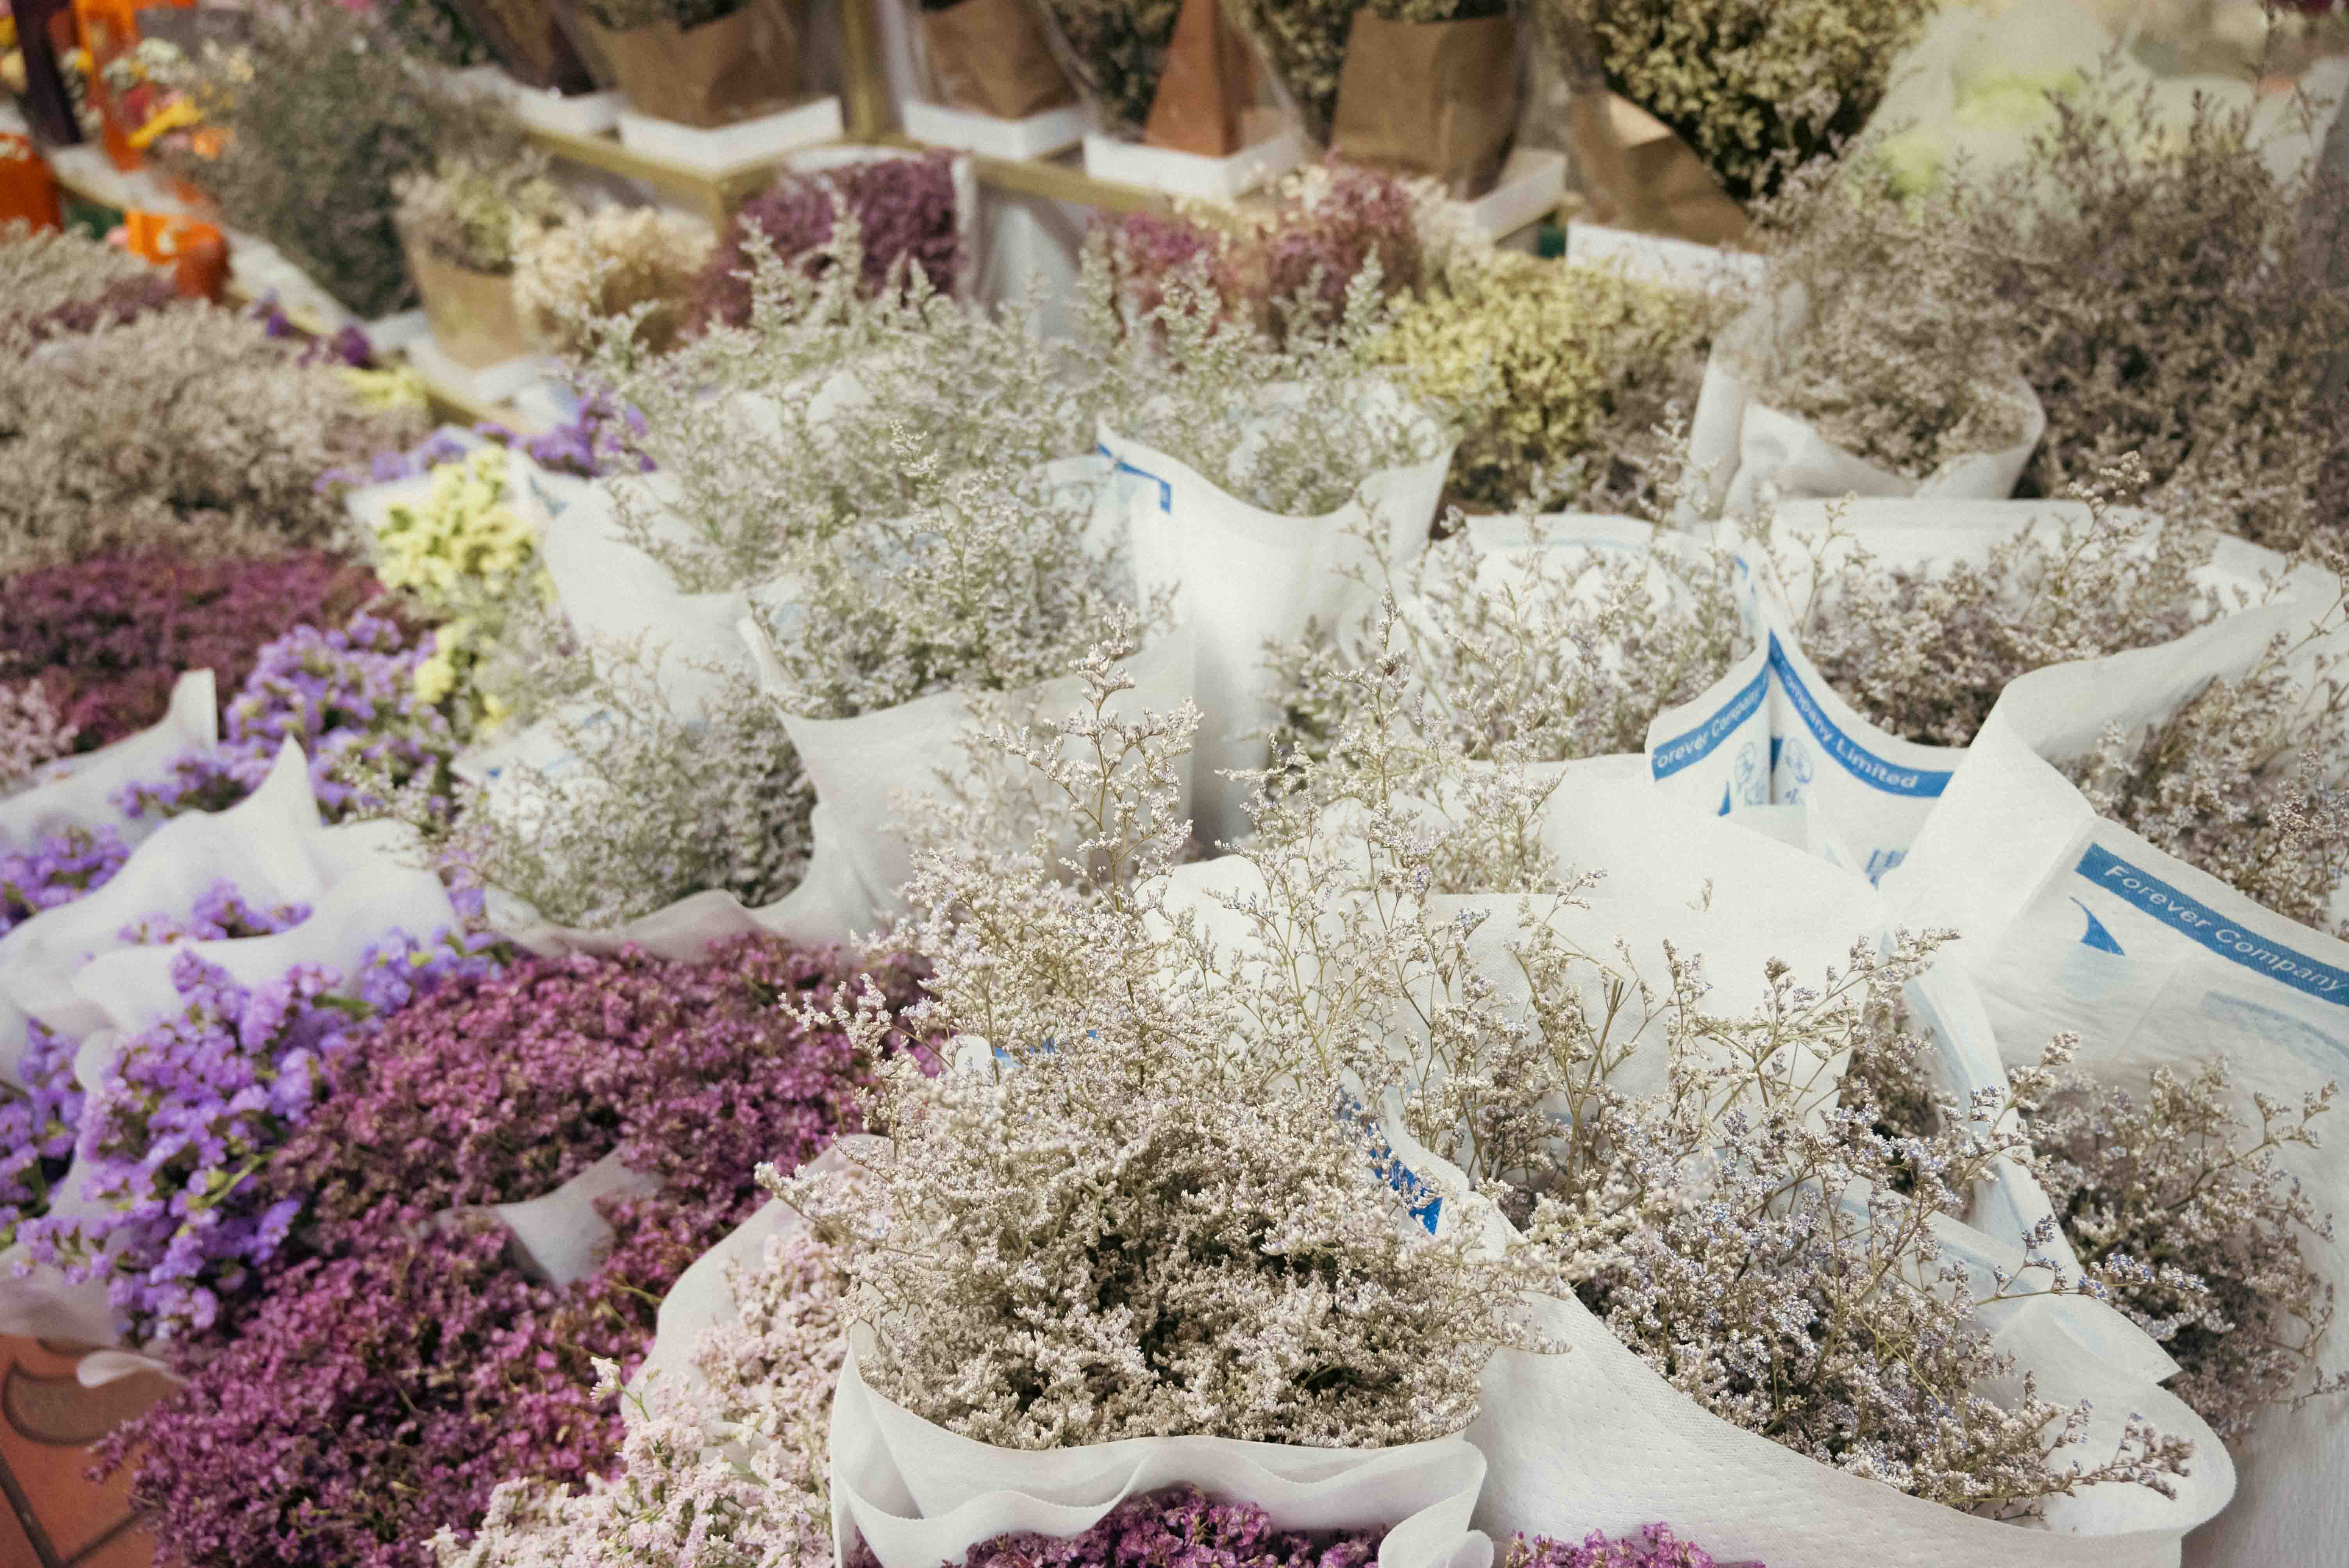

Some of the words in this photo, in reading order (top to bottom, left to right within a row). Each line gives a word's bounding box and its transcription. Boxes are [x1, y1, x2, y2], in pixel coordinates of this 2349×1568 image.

[1653, 729, 1709, 768] orever
[1836, 738, 1918, 789] Limited
[2104, 865, 2212, 927] Forever
[2215, 929, 2348, 992] Company
